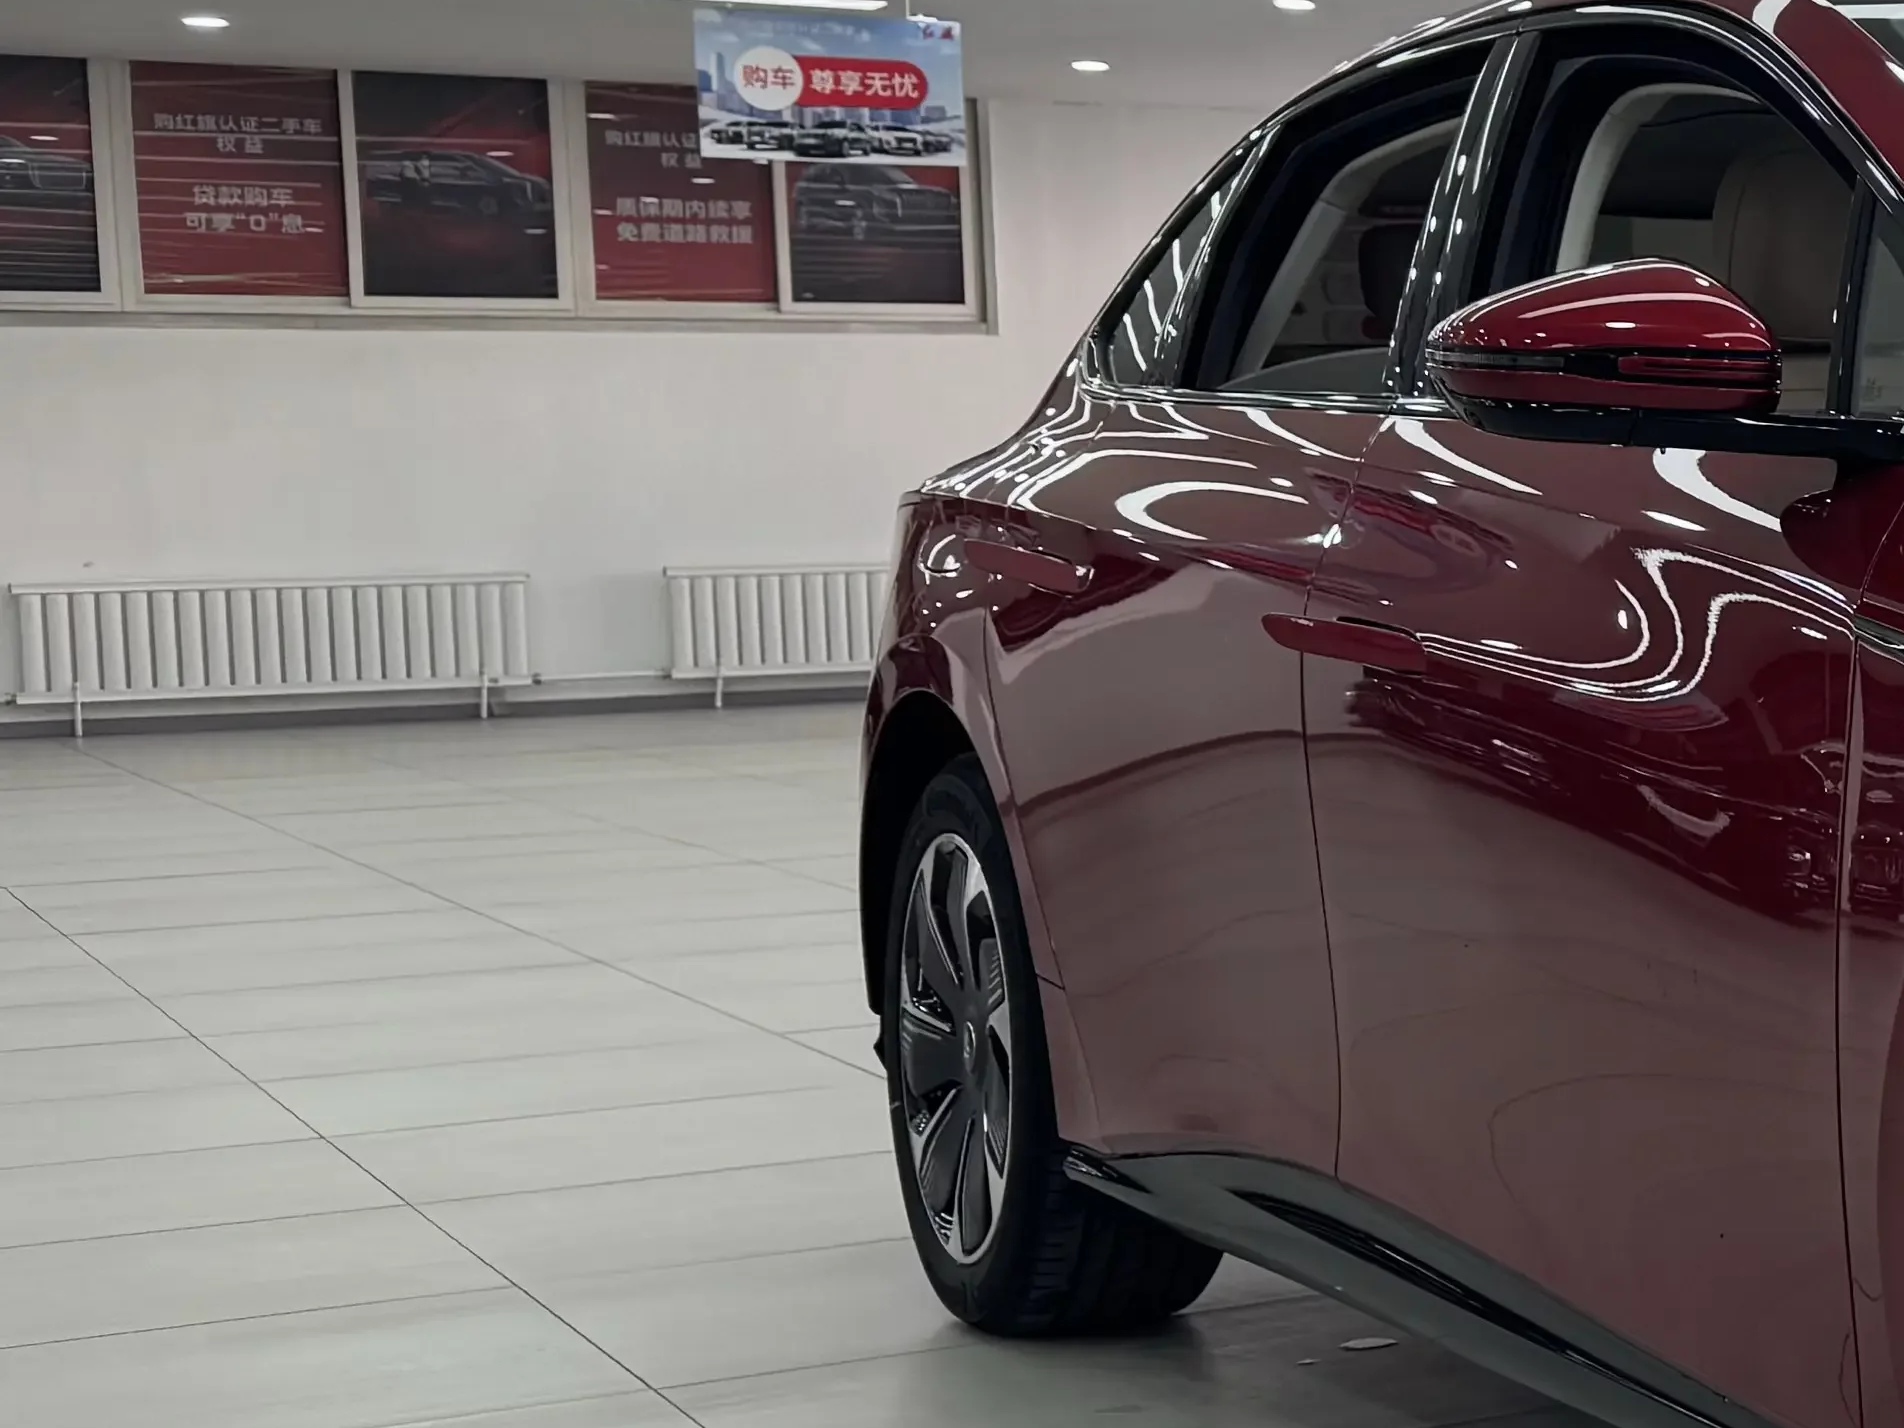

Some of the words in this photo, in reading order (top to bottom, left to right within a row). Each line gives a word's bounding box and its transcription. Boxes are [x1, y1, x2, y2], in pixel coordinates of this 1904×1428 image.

[742, 64, 796, 90] 购车
[808, 68, 920, 99] 尊享无忧
[153, 113, 322, 135] 购红旗认证二手车
